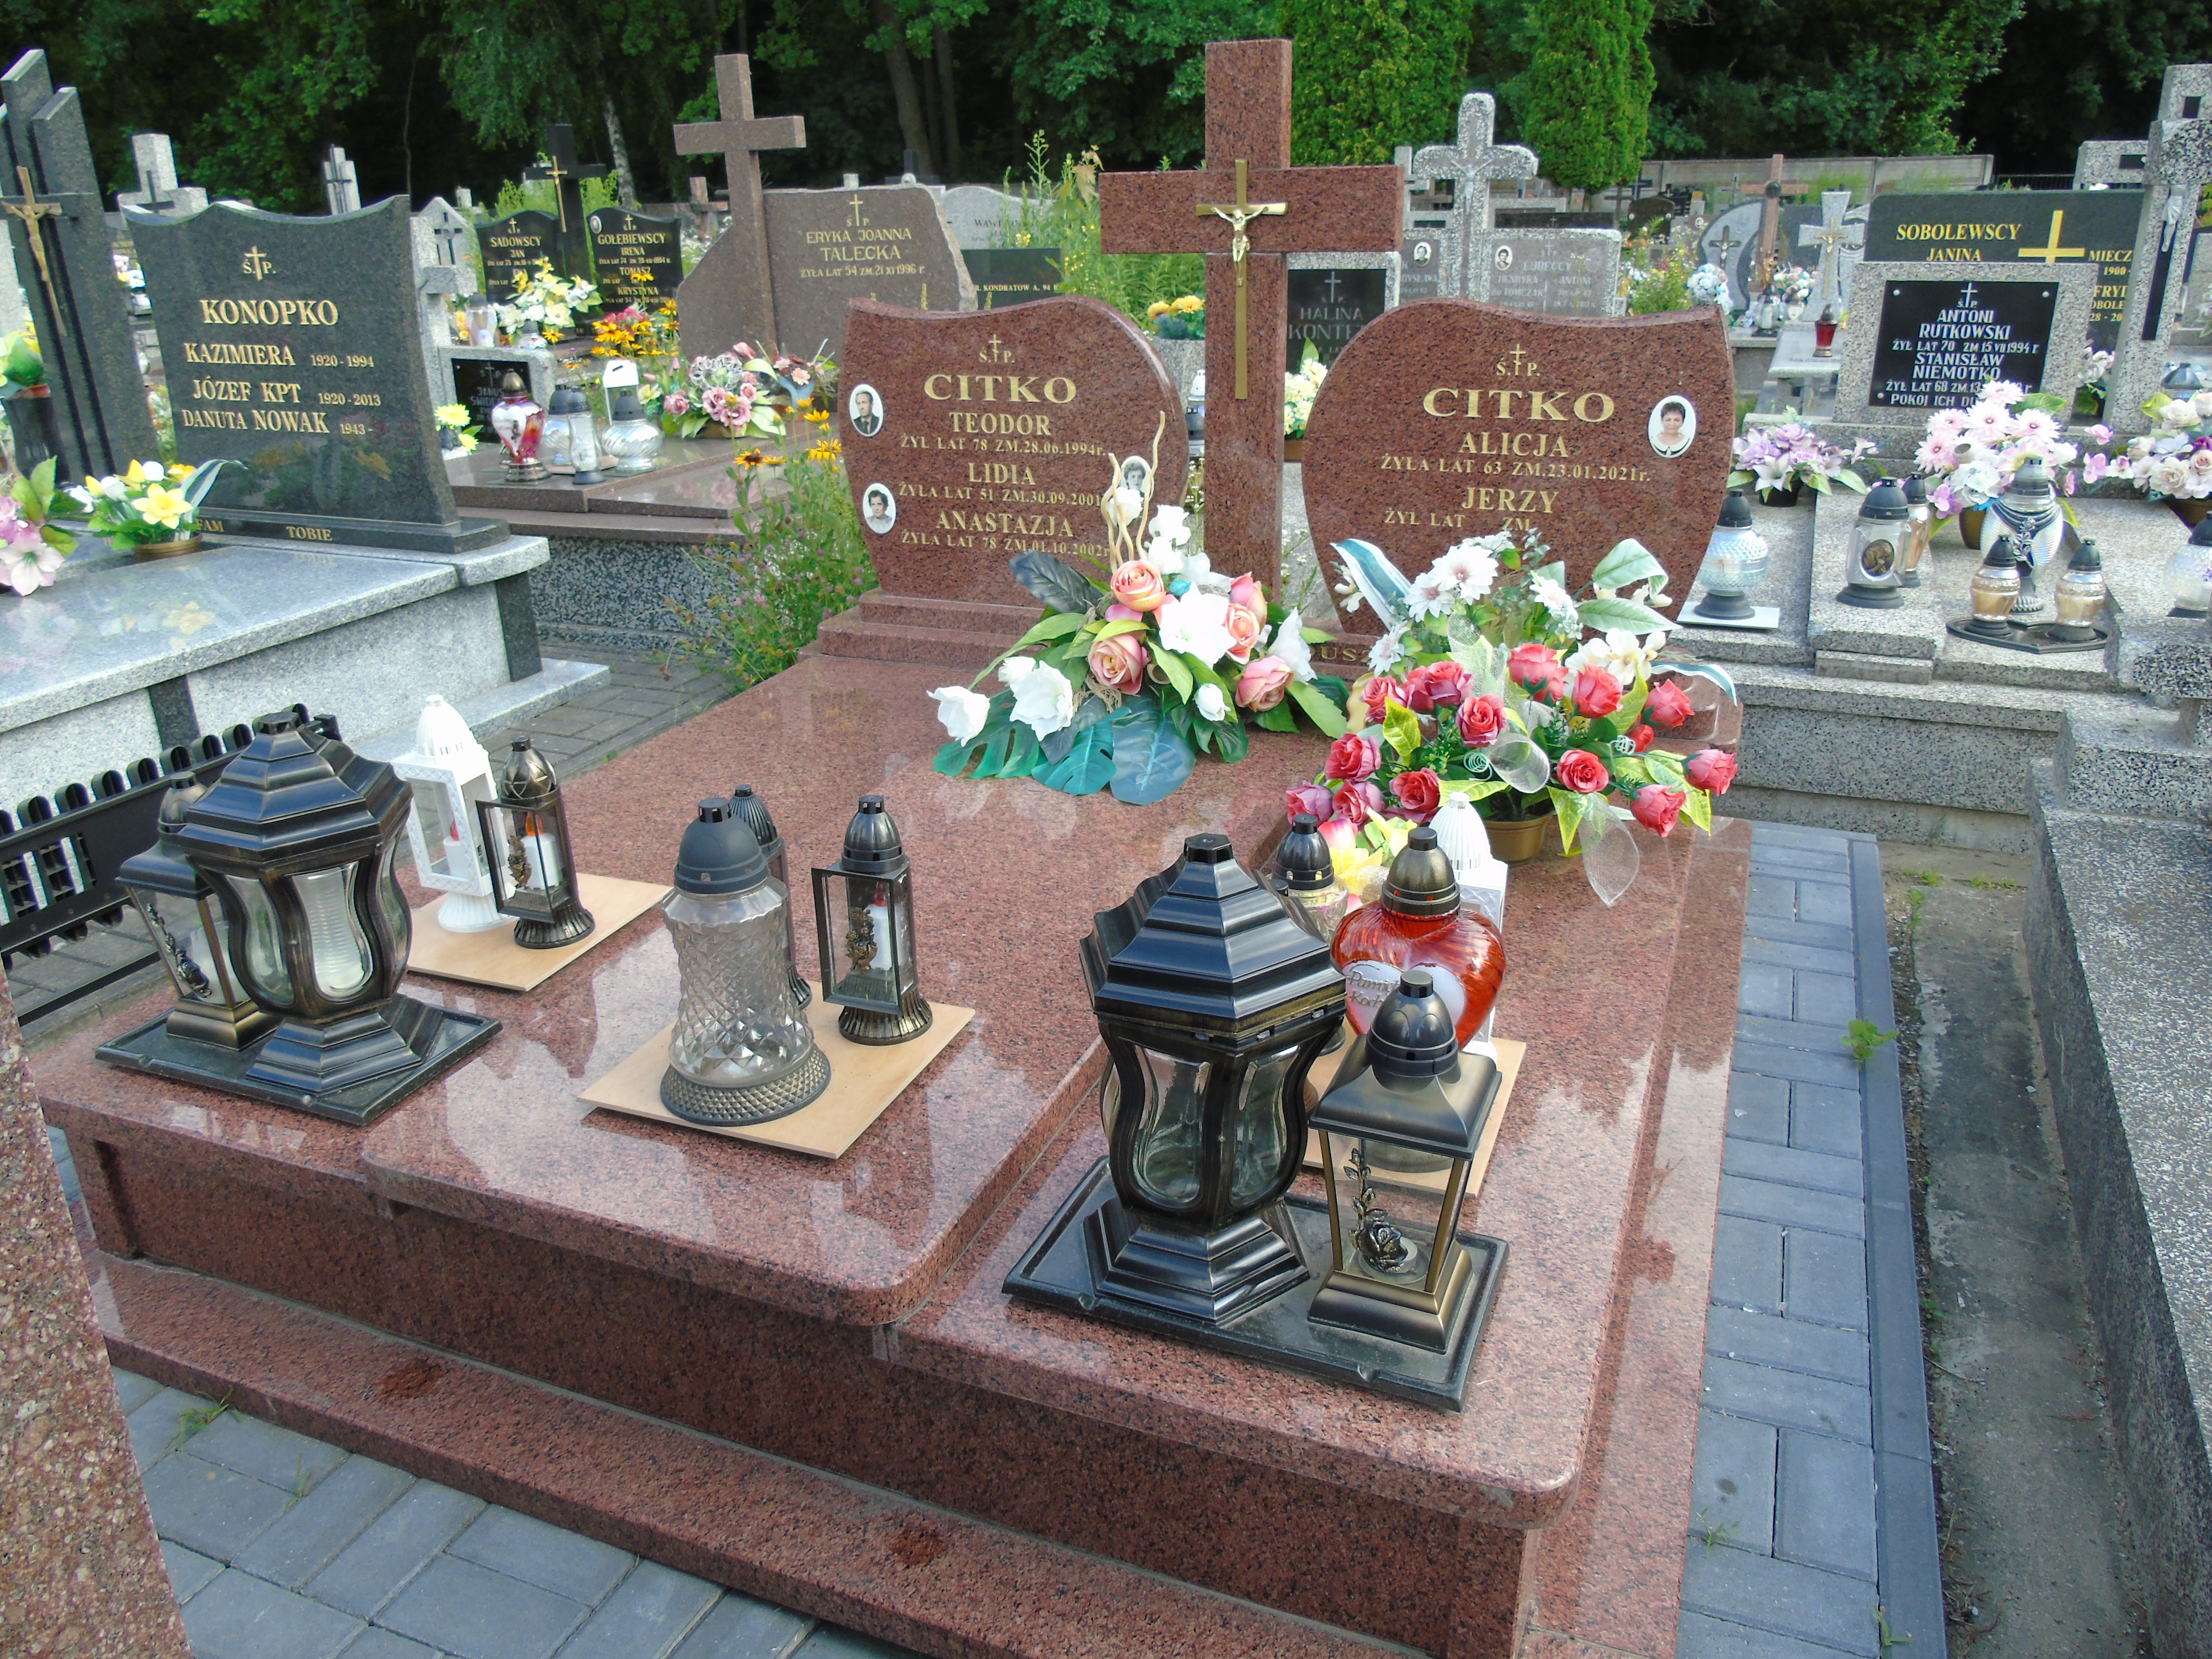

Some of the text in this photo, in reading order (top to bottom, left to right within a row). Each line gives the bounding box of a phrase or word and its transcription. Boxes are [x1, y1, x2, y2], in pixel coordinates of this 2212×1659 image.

[806, 228, 912, 243] ERYKA JOANNA
[1896, 223, 2021, 240] SOBOLEWSCY
[490, 236, 541, 247] SADOWSCY
[510, 249, 526, 258] JAN
[621, 247, 645, 255] IRENA
[820, 245, 901, 261] TALECKA
[1926, 248, 1981, 261] JANINA
[262, 261, 276, 274] P.
[826, 268, 842, 276] LAT
[845, 265, 857, 276] 54
[897, 264, 916, 274] 1996
[2104, 266, 2127, 276] 1900
[618, 287, 659, 295] KRYSTYNA
[200, 299, 339, 325] KONOPKO
[1300, 307, 1363, 320] HALINA
[1937, 309, 1995, 323] ANTONI
[1918, 323, 2011, 340] RUTKOWSKI
[1916, 341, 1938, 351] LAT
[1940, 340, 1955, 352] 70
[1963, 342, 1978, 352] ZM
[184, 343, 297, 366] KAZIMIERA
[310, 354, 338, 367] 1920
[347, 355, 374, 368] 1994
[979, 347, 1015, 363] Ś. P.
[1914, 352, 2004, 366] STANISŁAW
[1496, 358, 1540, 376] Ś. P.
[1912, 365, 2001, 380] NIEMOTKO
[193, 376, 252, 401] JÓZEF
[260, 382, 301, 403] KPT
[318, 392, 346, 405] 1920
[354, 394, 381, 406] 2013
[924, 374, 1077, 404] CITKO
[1911, 382, 1932, 392] LAT
[1934, 381, 1948, 392] 68
[1423, 388, 1615, 422] CITKO
[1890, 393, 1929, 406] POKOJ
[1934, 395, 1955, 406] ICH
[181, 409, 248, 430] DANUTA
[252, 410, 331, 434] NOWAK
[340, 423, 365, 434] 1943
[949, 412, 1051, 435] TEODOR
[937, 437, 966, 450] LAT
[973, 438, 988, 450] 78
[1459, 431, 1569, 458] ALICJA
[1439, 458, 1474, 473] LAT
[1484, 462, 1502, 474] 63
[969, 463, 1036, 485] LIDIA
[945, 486, 973, 499] LAT
[980, 488, 994, 500] 51
[1003, 489, 1102, 506] ZM.30.09.2001
[1462, 487, 1559, 514] JERZY
[936, 510, 1074, 537] ANASTAZJA
[1430, 513, 1465, 527] LAT
[195, 519, 333, 541] FAM TOBIE
[947, 534, 975, 547] LAT
[982, 537, 997, 549] 78
